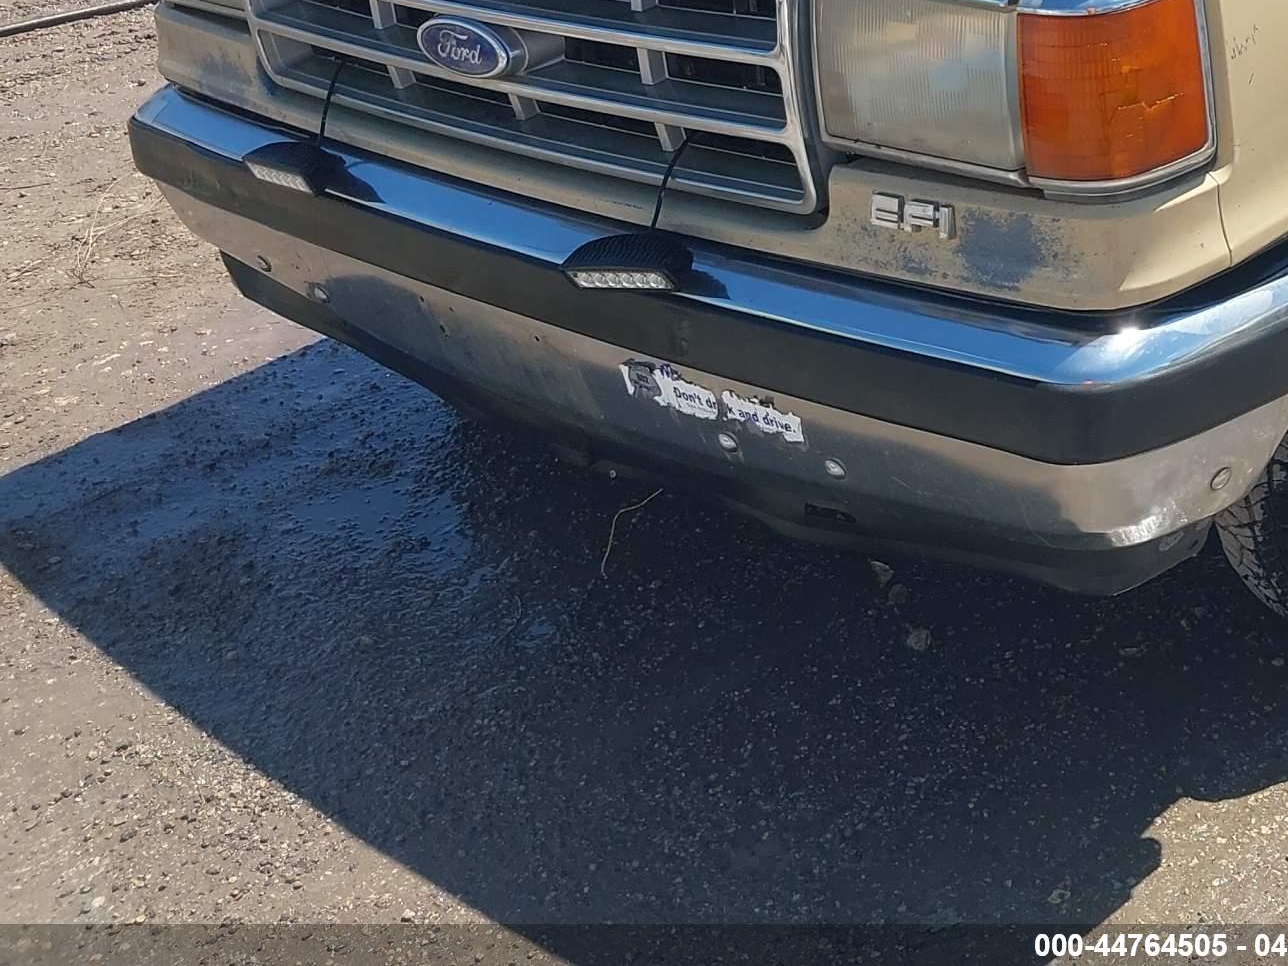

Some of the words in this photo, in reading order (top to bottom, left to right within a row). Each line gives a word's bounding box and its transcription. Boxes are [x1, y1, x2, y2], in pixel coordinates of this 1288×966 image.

[437, 29, 483, 65] Ford
[871, 193, 957, 240] EFI
[673, 386, 704, 407] Don't
[705, 397, 736, 415] drk
[738, 409, 760, 423] and
[762, 412, 797, 434] drive.
